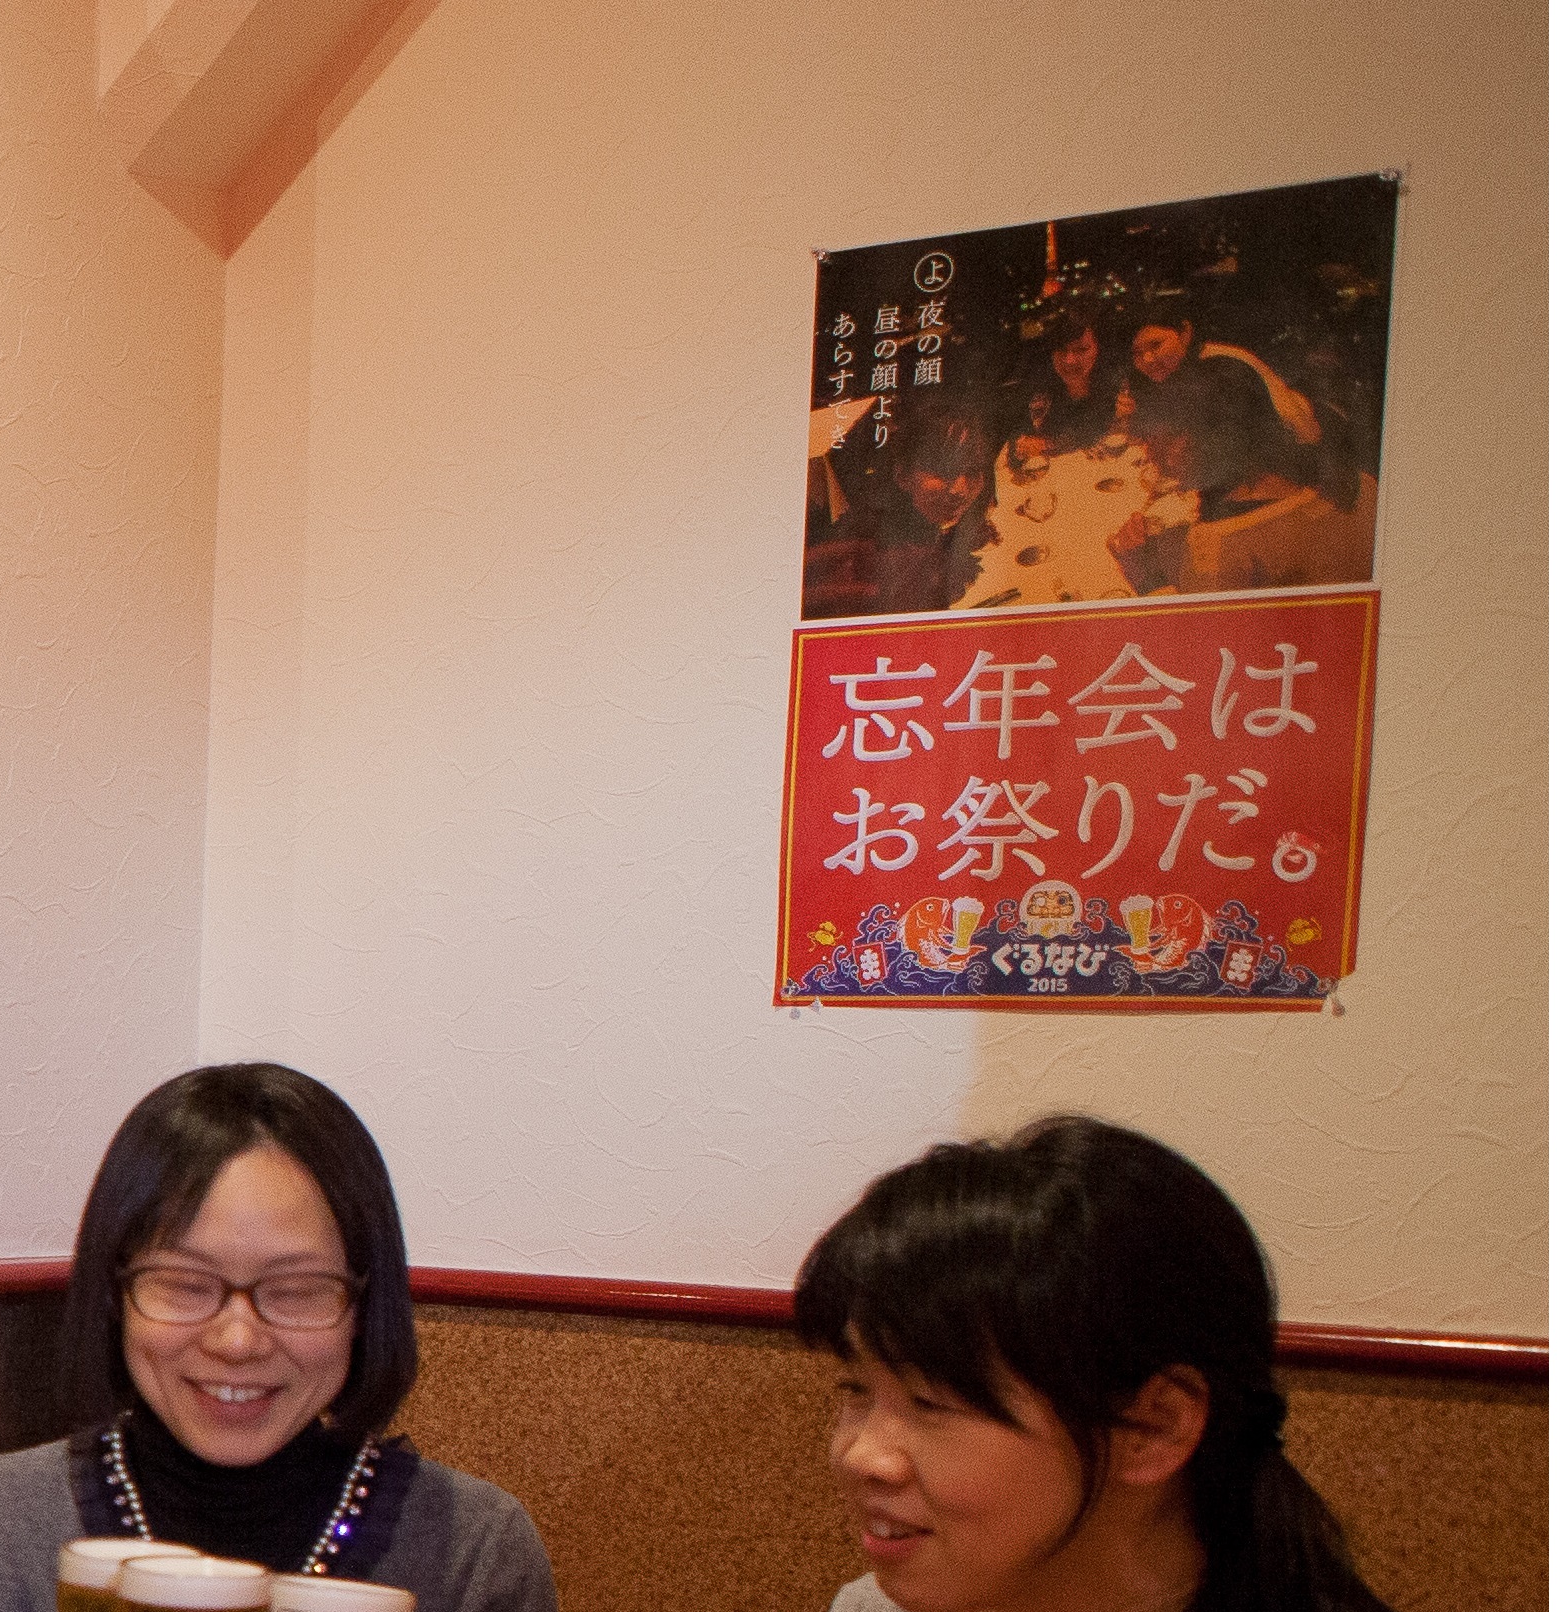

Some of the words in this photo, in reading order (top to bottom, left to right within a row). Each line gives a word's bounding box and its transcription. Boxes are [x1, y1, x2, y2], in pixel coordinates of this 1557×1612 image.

[870, 305, 901, 449] 昼の顔より
[913, 299, 945, 386] 夜の顔
[821, 642, 1319, 762] 忘年会は
[991, 942, 1107, 976] ぐるなび
[1027, 977, 1068, 993] 2015
